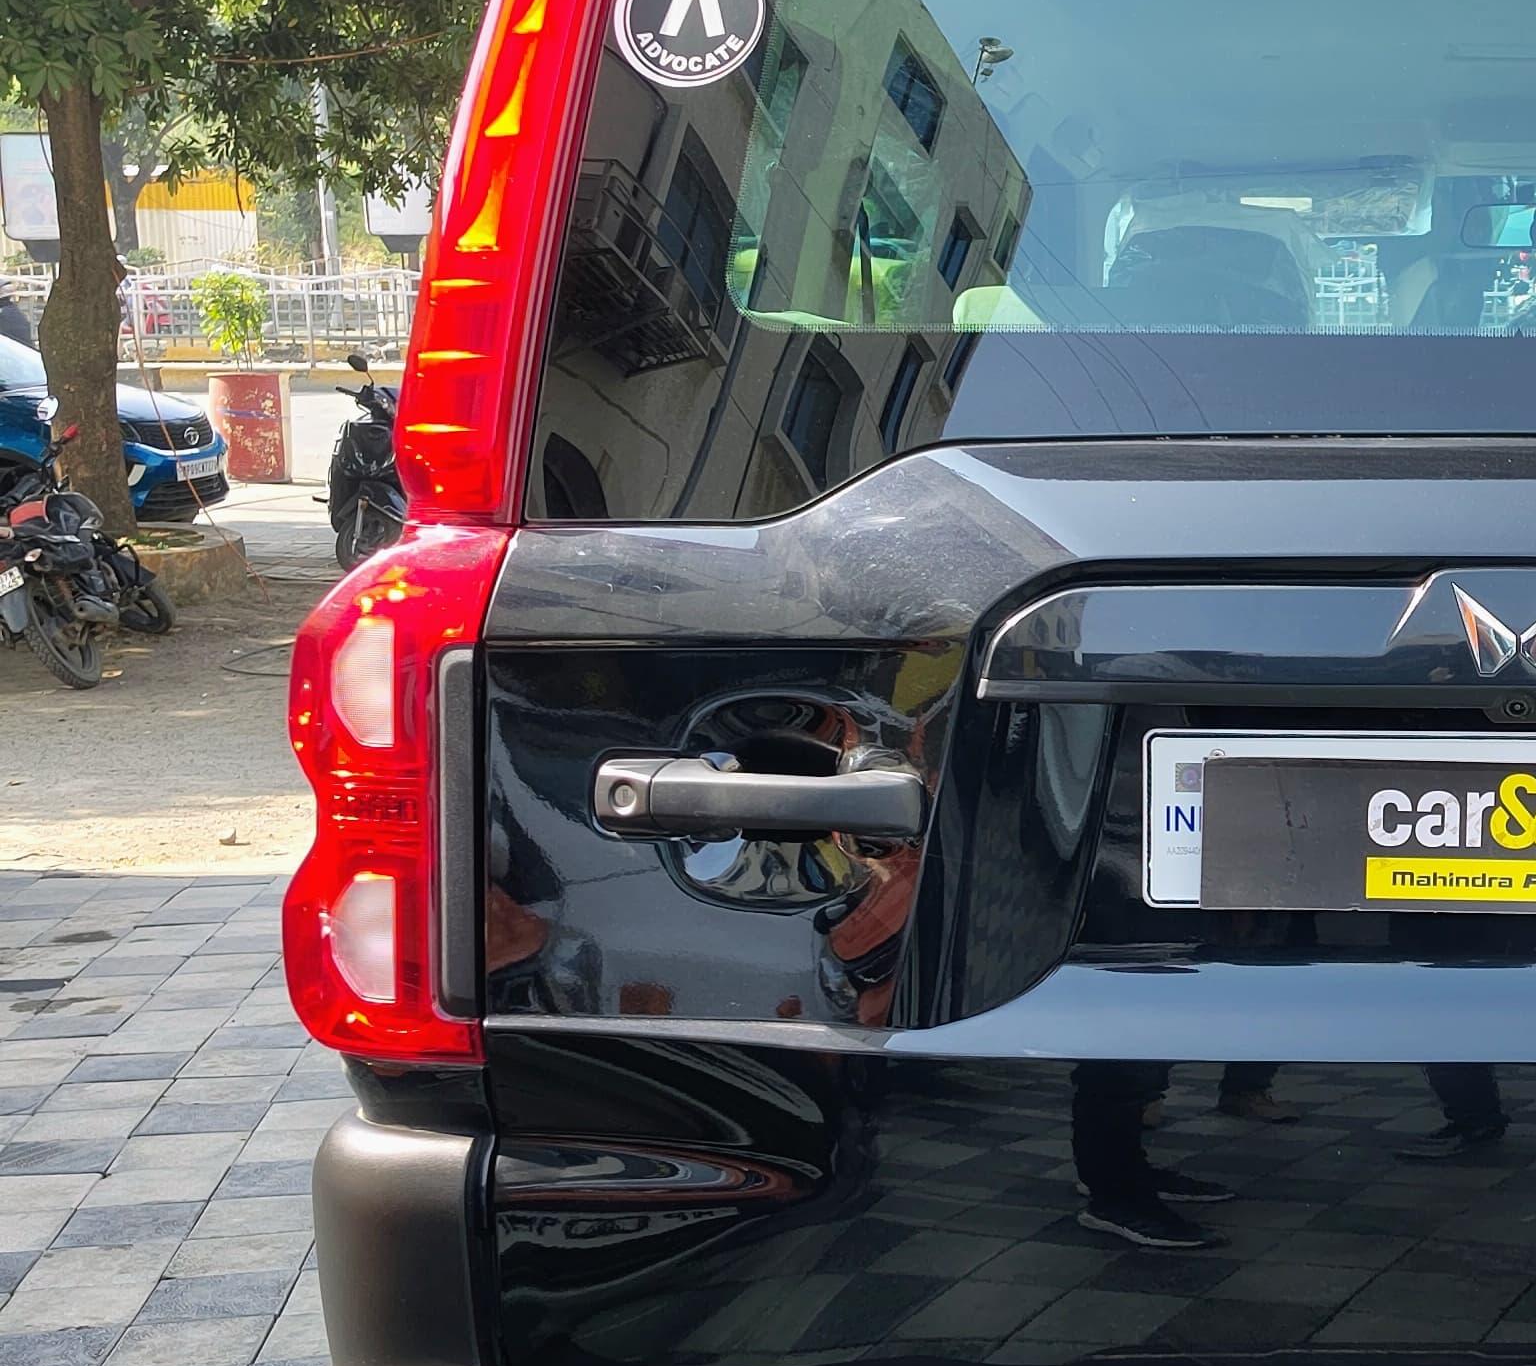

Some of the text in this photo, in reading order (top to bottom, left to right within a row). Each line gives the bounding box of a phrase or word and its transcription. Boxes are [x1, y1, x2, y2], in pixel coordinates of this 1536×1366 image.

[636, 31, 745, 72] ADVOCATE
[1166, 805, 1202, 832] IN
[1392, 871, 1514, 888] Mahindra
